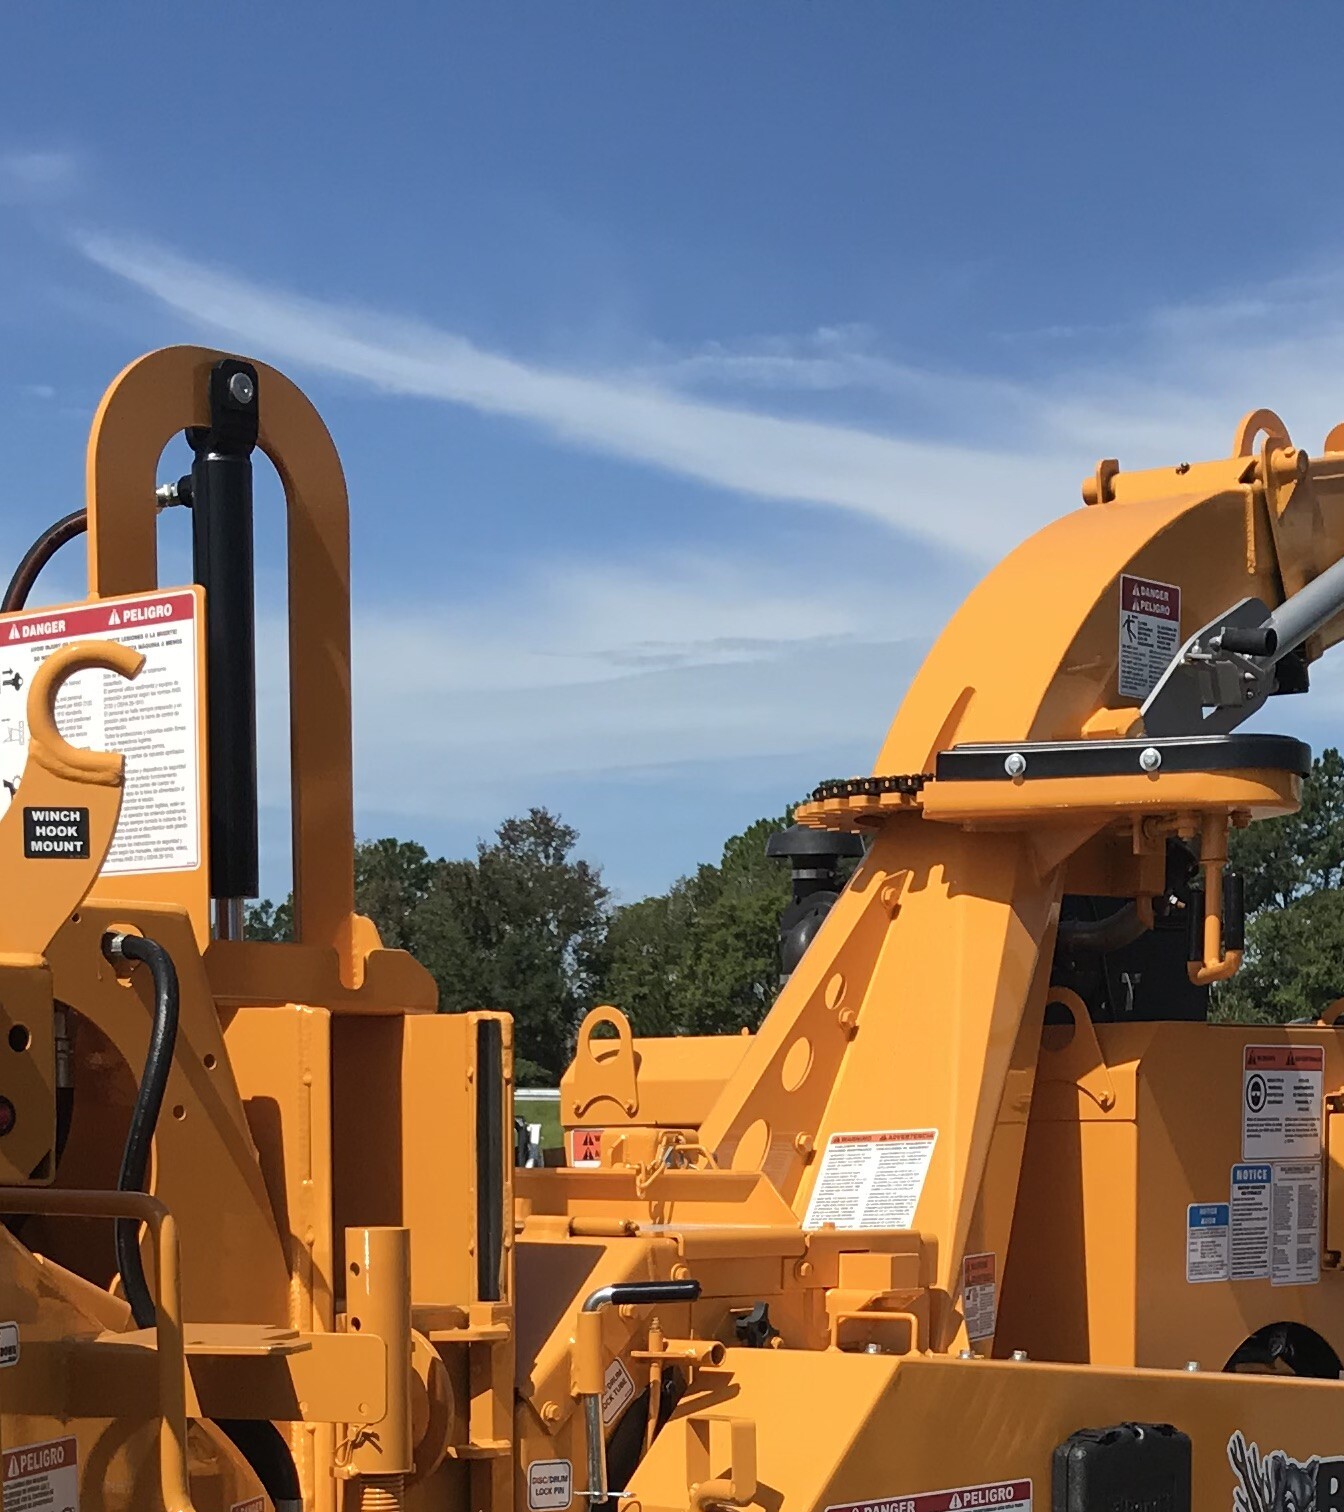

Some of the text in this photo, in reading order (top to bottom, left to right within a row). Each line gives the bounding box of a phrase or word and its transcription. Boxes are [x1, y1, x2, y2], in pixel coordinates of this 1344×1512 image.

[123, 603, 173, 623] PELIGRO
[22, 619, 66, 638] DANGER
[31, 810, 81, 822] WINCH
[35, 825, 78, 837] HOOK
[30, 840, 84, 852] MOUNT
[1236, 1169, 1268, 1180] NOTICE
[20, 1446, 65, 1473] PELIGRO
[532, 1474, 569, 1485] DISC/DRUM
[535, 1486, 565, 1496] LOCK PIN
[963, 1486, 1014, 1507] PELIGRO
